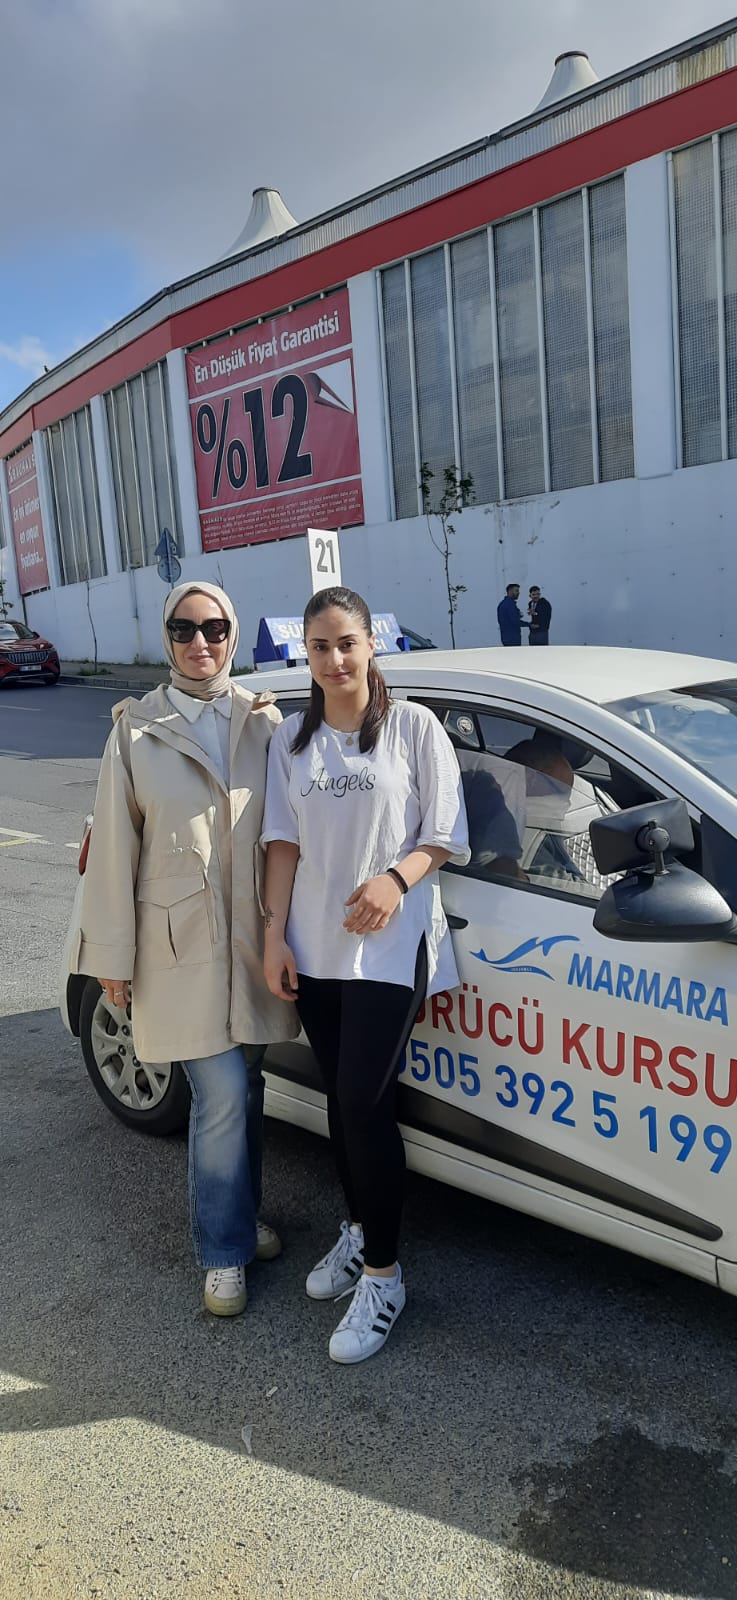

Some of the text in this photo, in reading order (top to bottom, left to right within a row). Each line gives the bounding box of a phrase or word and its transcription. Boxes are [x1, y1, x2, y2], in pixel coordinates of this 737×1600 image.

[194, 310, 340, 384] En Düşük Fiyat Garantisi
[196, 373, 313, 499] %12
[315, 537, 336, 574] 21
[300, 766, 376, 798] Angels
[567, 952, 730, 1027] MARMARA
[562, 1018, 737, 1108] KURSU
[494, 1064, 577, 1128] 392
[592, 1090, 619, 1140] 5
[639, 1105, 732, 1175] 199
